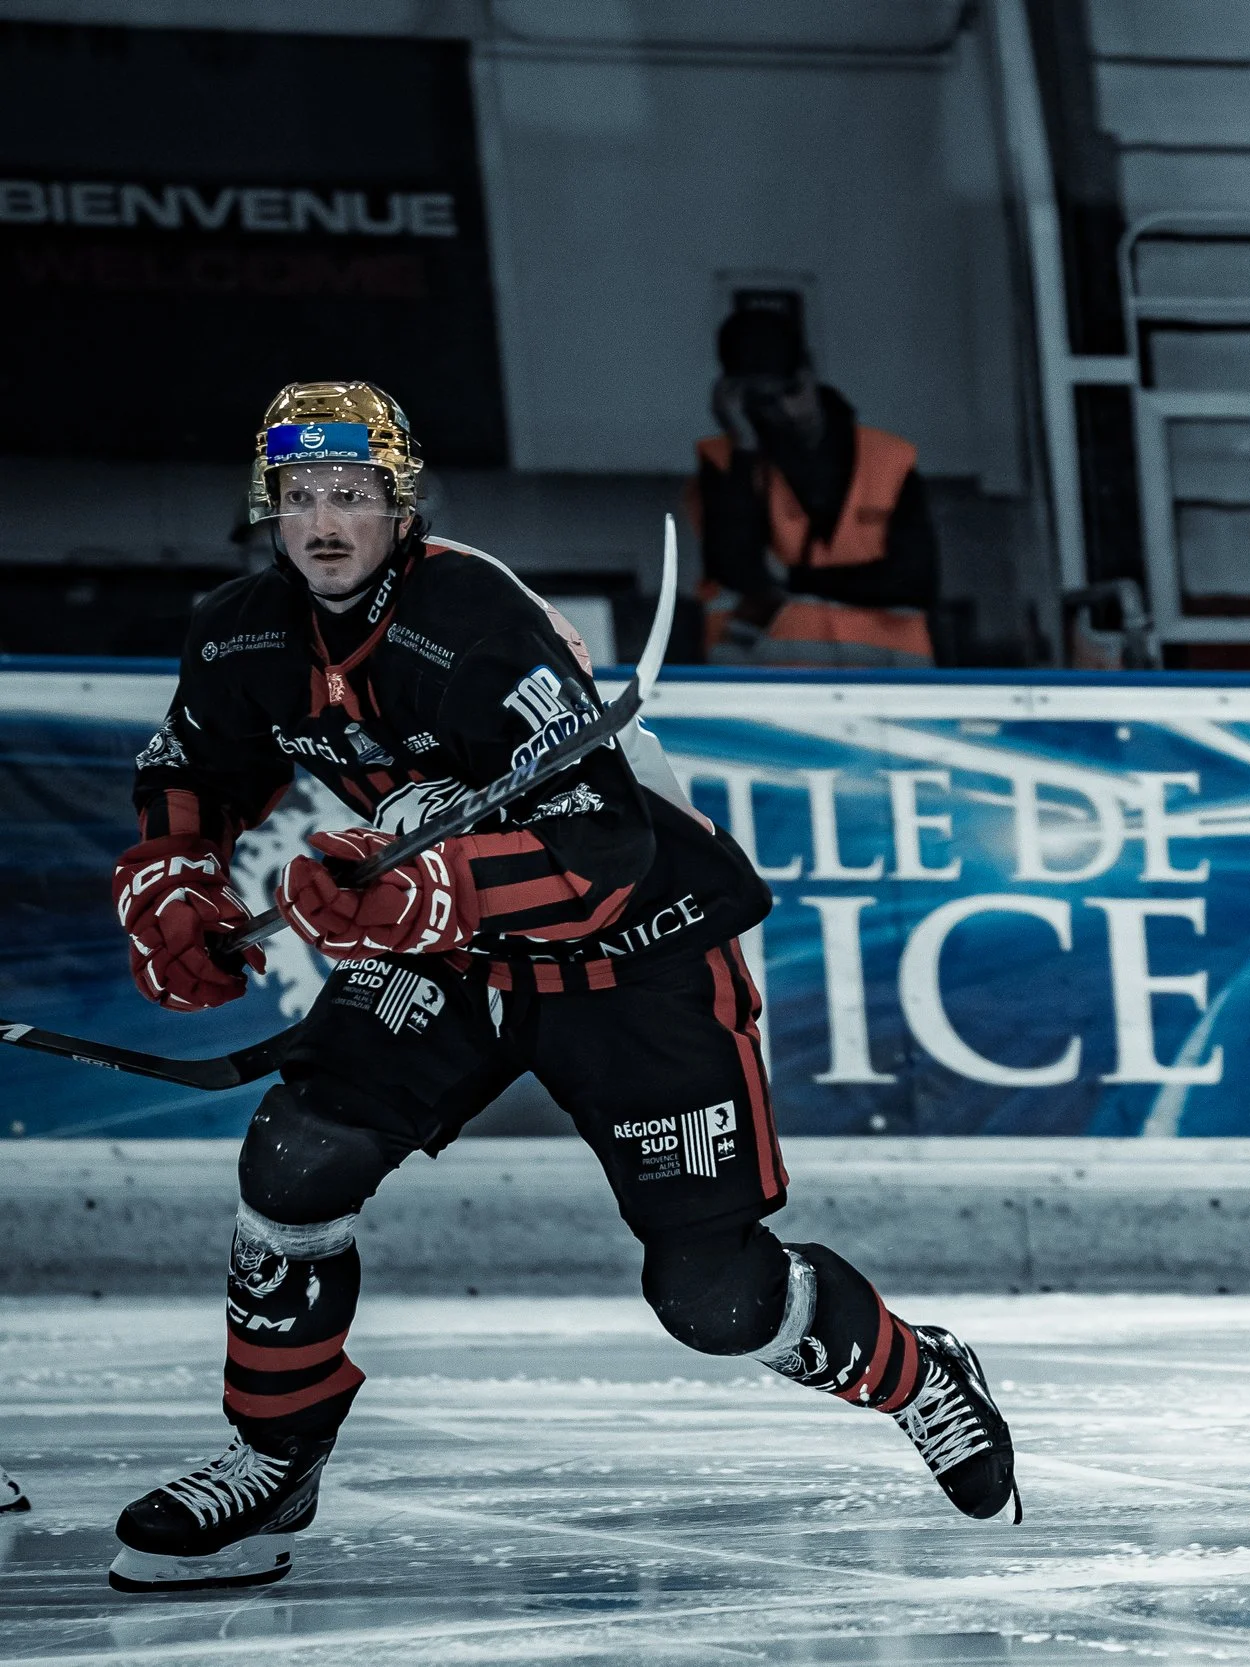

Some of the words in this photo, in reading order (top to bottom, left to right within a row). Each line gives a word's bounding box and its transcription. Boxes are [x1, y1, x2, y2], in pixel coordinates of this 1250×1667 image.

[0, 178, 461, 239] BIENVENUE
[367, 568, 397, 624] CCM
[502, 667, 568, 732] TOP
[690, 768, 963, 882] LLE
[1012, 770, 1210, 883] DE
[117, 858, 215, 927] CCM
[347, 972, 384, 989] SUD
[613, 1115, 677, 1139] RÉGION
[641, 1135, 679, 1155] SUD
[659, 1161, 681, 1171] ALPES
[228, 1296, 297, 1332] CM
